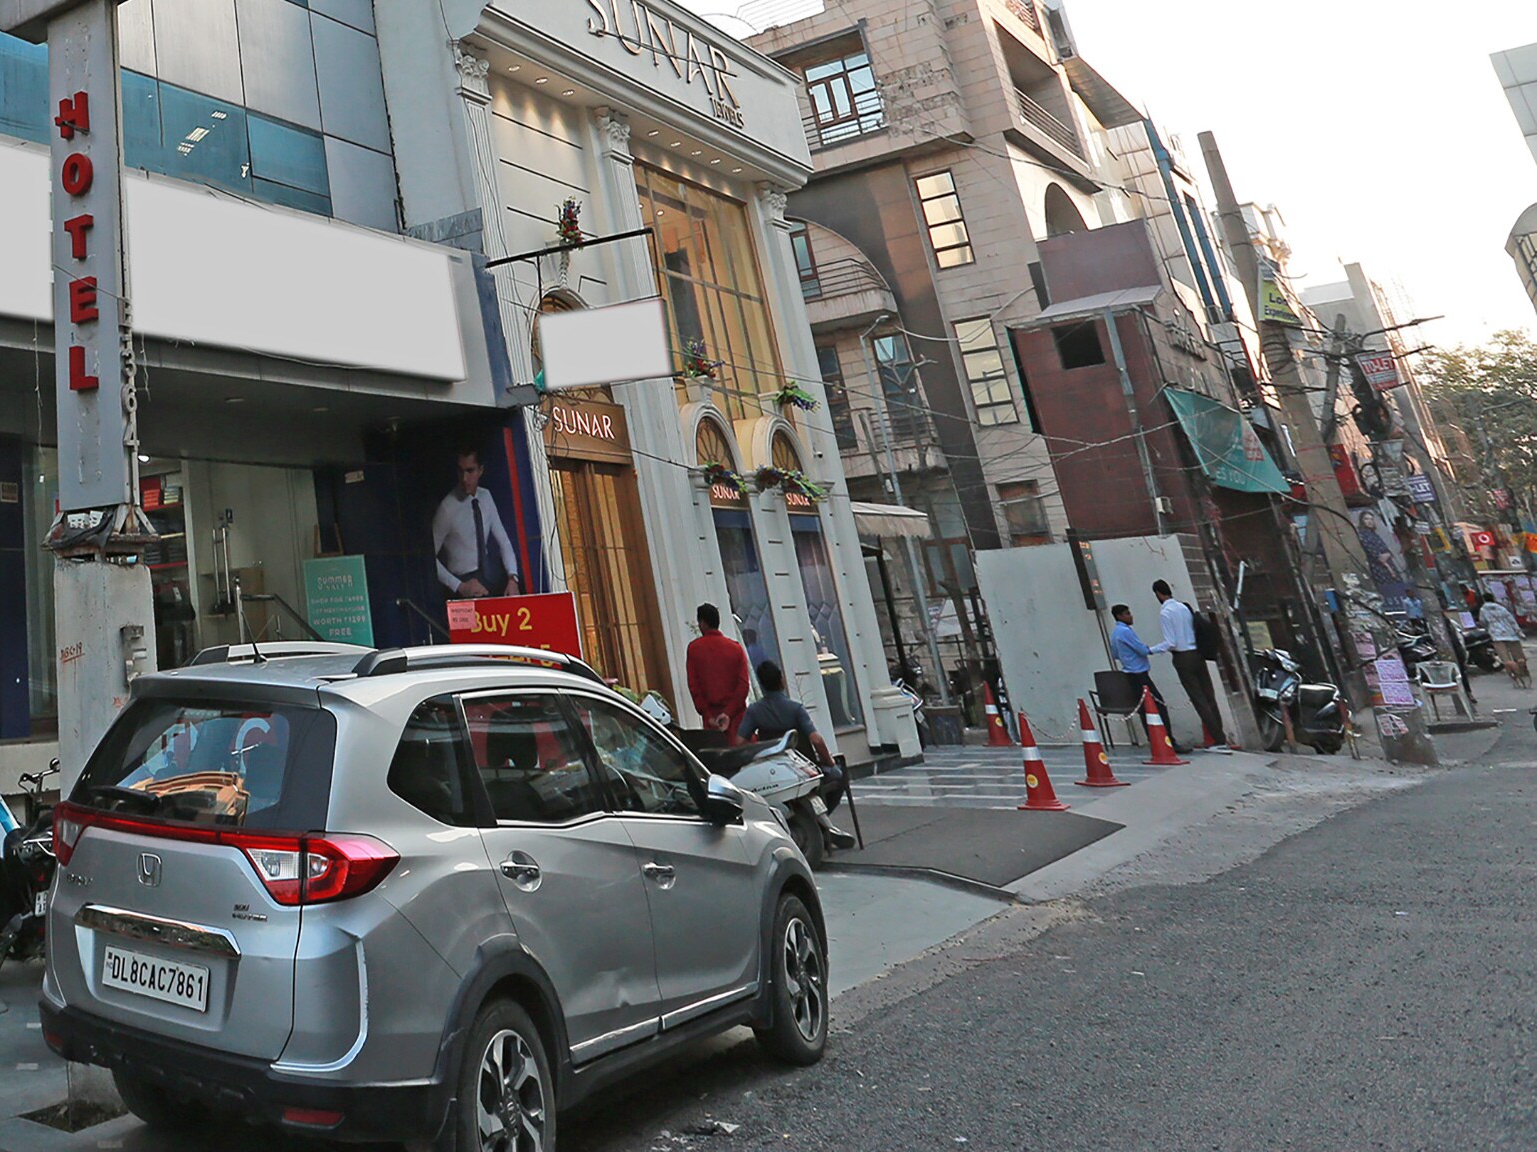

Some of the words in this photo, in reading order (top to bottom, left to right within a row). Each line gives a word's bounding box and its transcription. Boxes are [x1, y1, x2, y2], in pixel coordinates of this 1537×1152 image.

[55, 90, 99, 392] HOTEL
[553, 406, 615, 440] SUNAR
[313, 617, 342, 625] WORTH
[329, 627, 352, 636] FREE
[471, 610, 510, 637] Buy
[517, 607, 533, 630] 2
[112, 955, 204, 1002] DL8CAC7861
